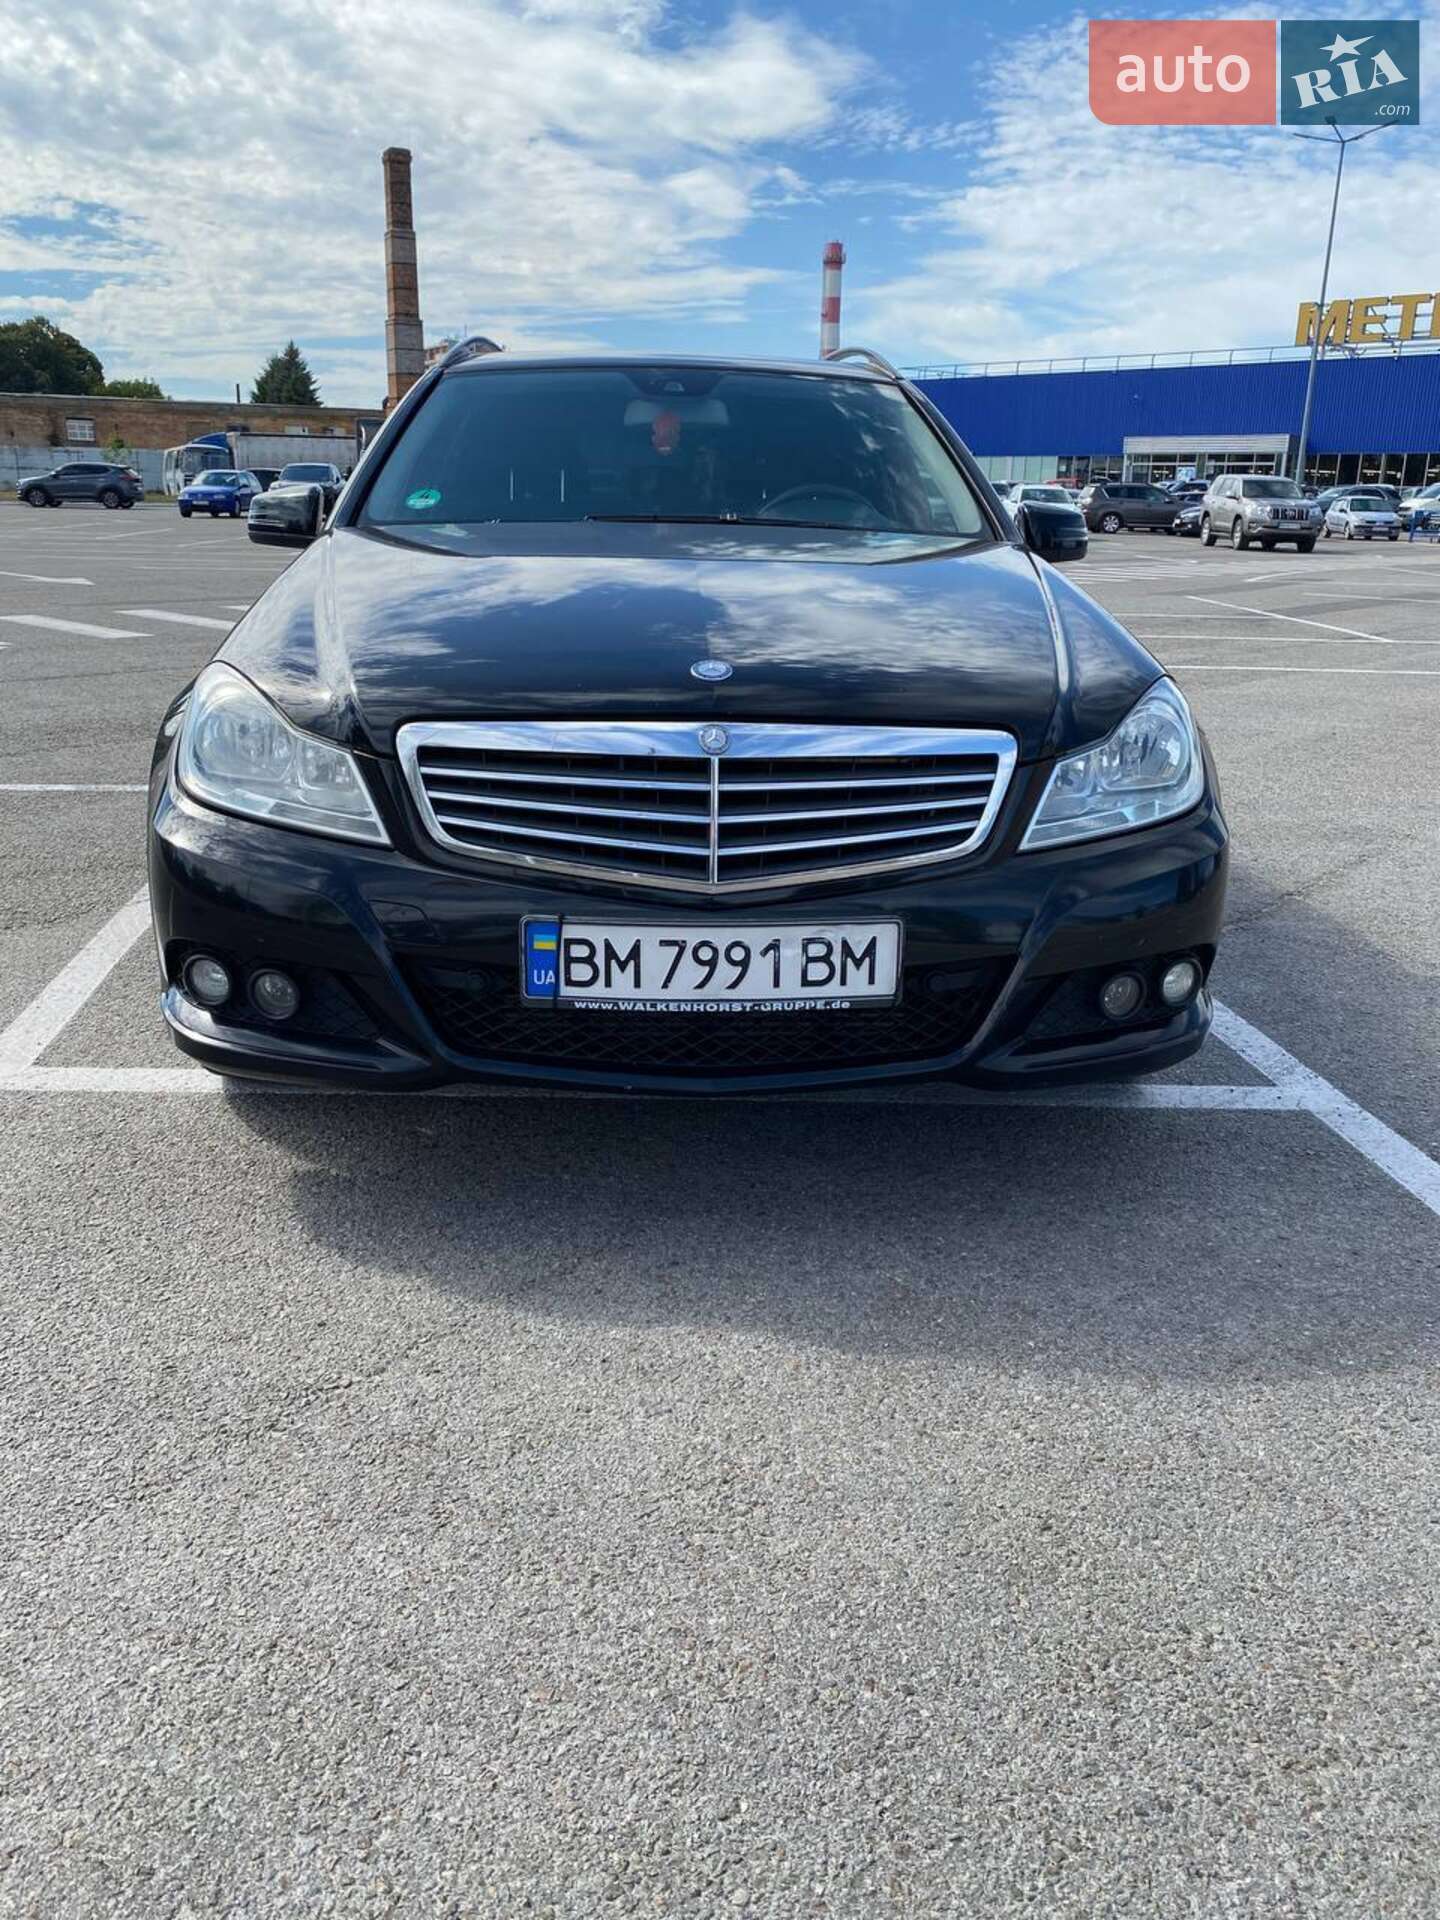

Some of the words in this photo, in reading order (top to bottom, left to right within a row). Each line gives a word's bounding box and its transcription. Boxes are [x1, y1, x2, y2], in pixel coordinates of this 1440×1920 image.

[1295, 292, 1440, 347] MET
[533, 969, 556, 986] UA
[563, 938, 642, 989] BM
[658, 938, 782, 990] 7991
[800, 936, 877, 987] BM
